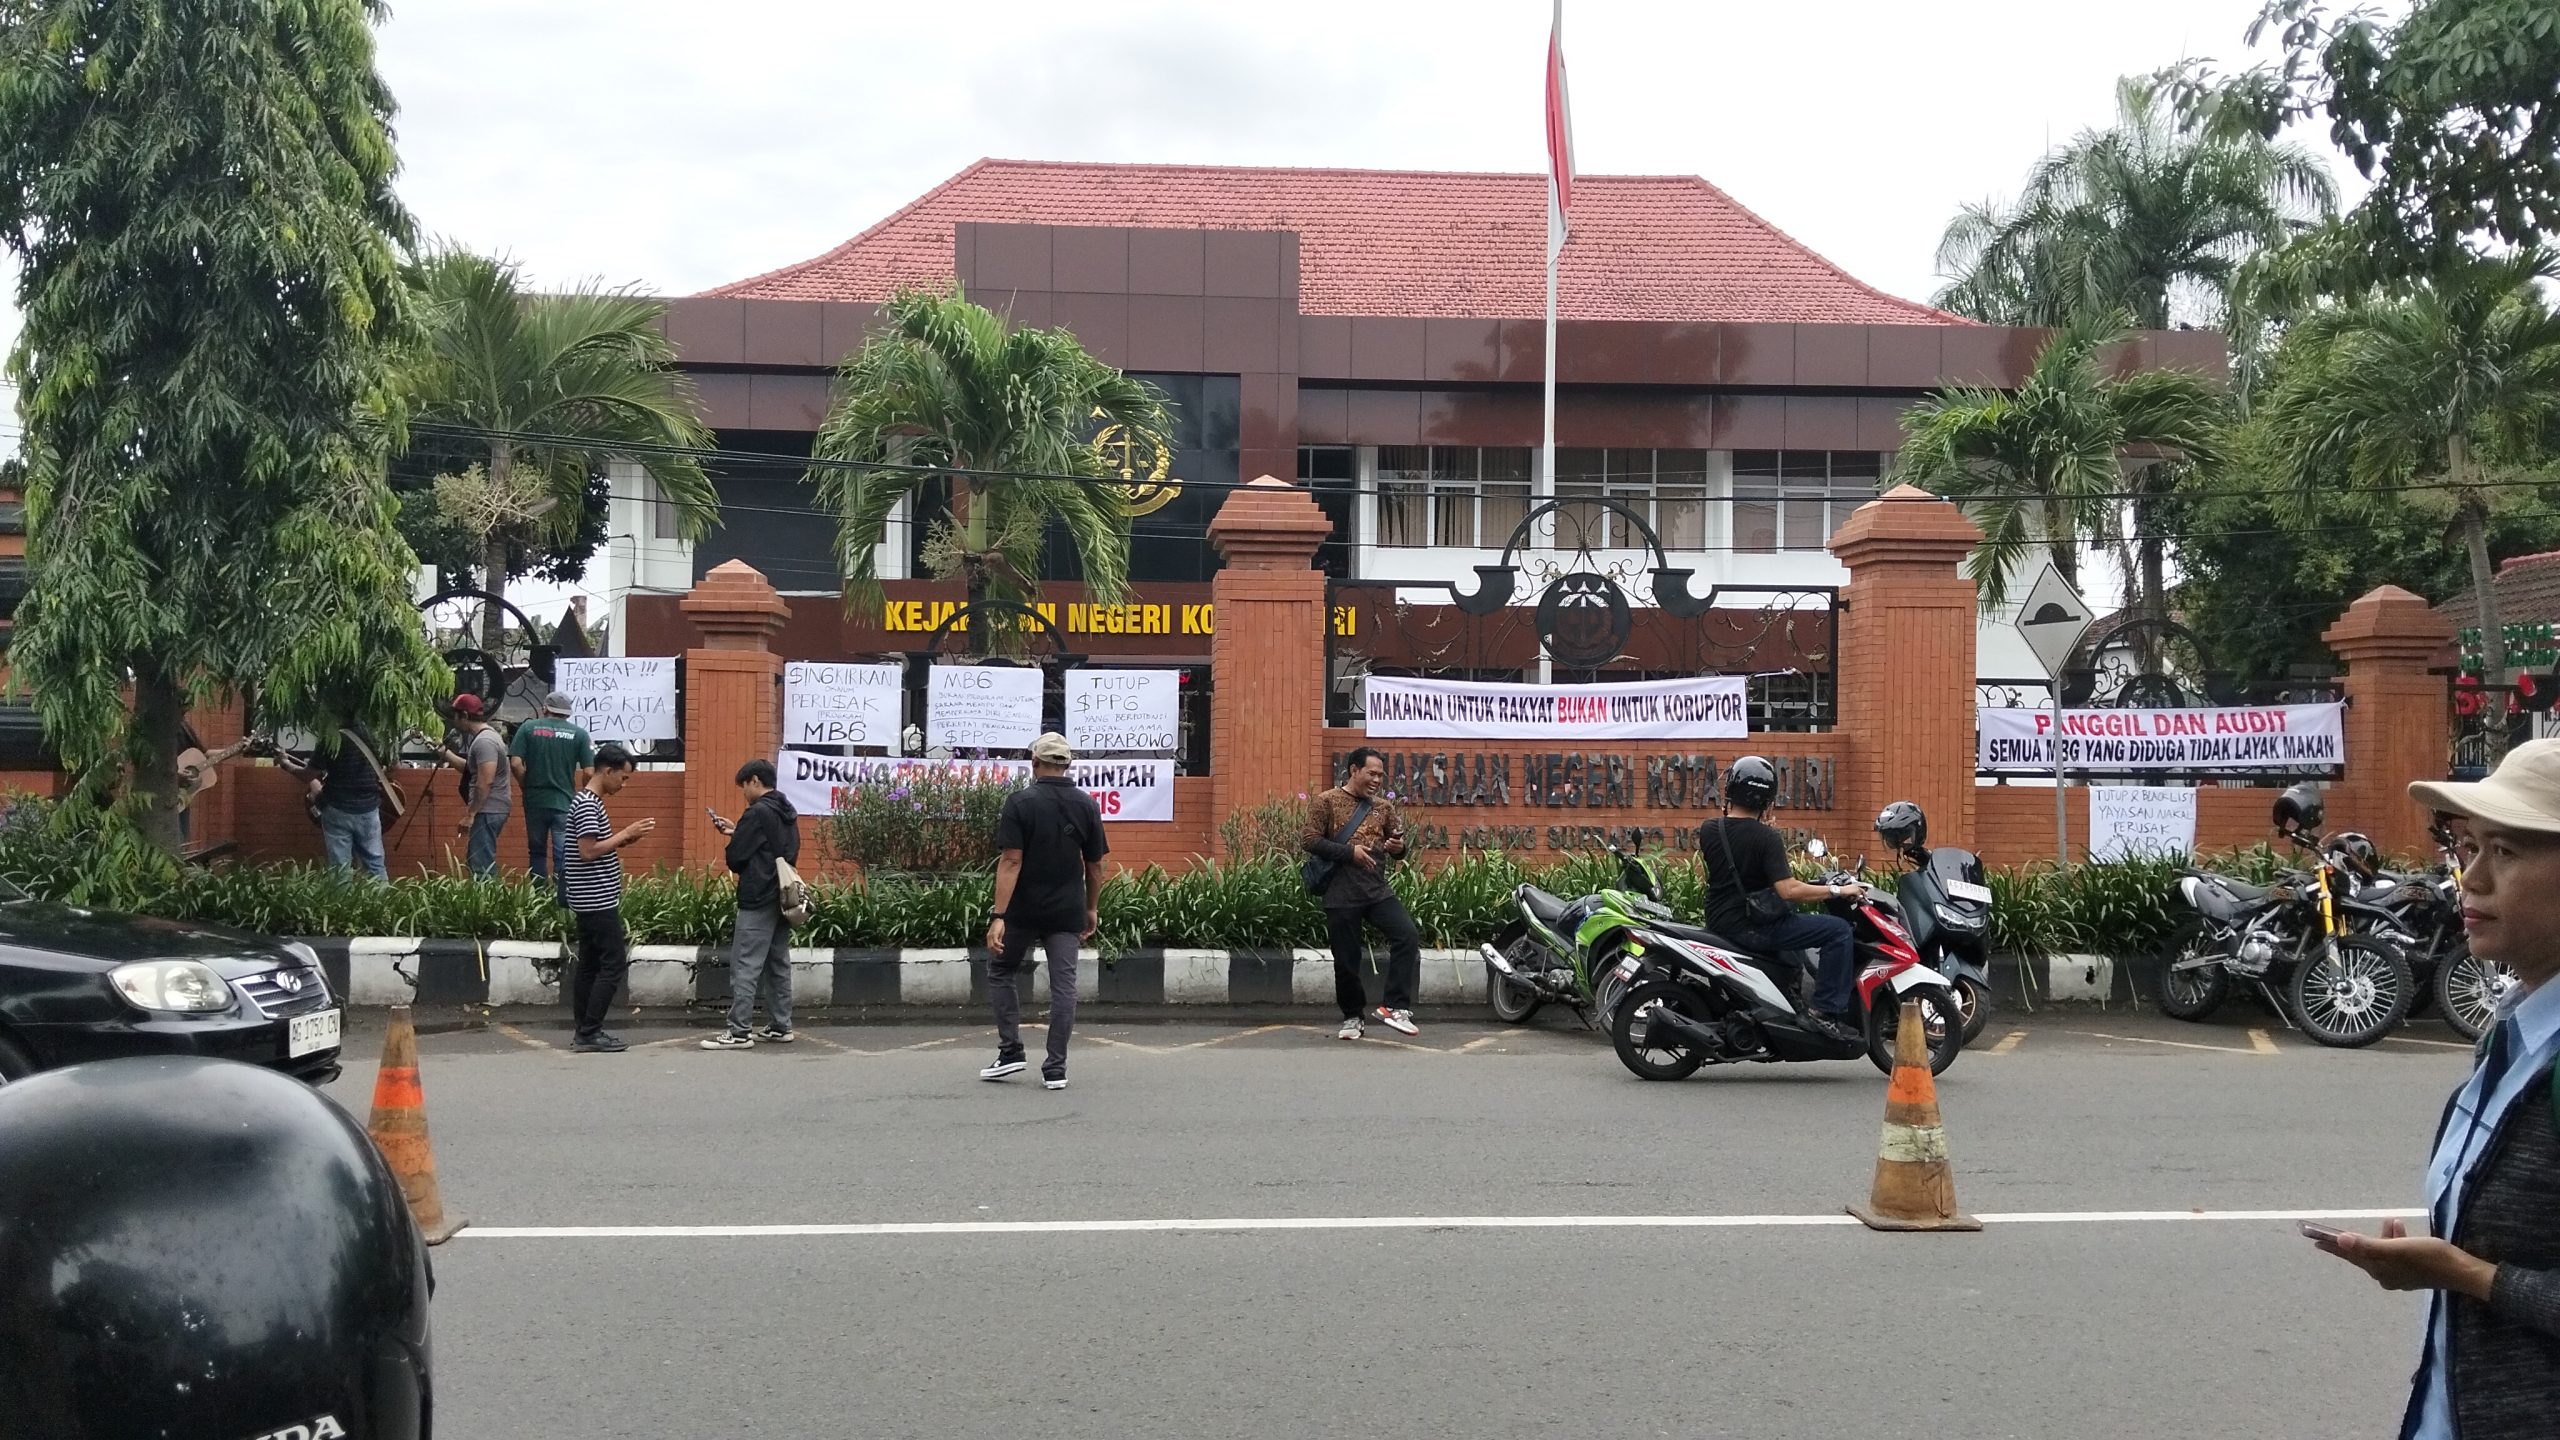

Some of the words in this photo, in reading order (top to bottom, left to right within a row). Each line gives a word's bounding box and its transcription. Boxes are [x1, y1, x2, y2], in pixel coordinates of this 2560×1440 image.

[1068, 603, 1171, 634] NEGERI
[1091, 677, 1150, 690] TUTUP
[622, 696, 666, 714] KITA
[1370, 692, 1443, 721] MAKANAN
[1447, 694, 1495, 723] UNTUK
[1499, 696, 1554, 723] RAKYAT
[1557, 696, 1607, 723] BUKAN
[1611, 695, 1660, 723] UNTUK
[1663, 693, 1742, 722] KORUPTOR
[2153, 713, 2207, 736] DAN
[2215, 710, 2286, 734] AUDIT
[1094, 733, 1173, 748] PRABOWO
[1989, 739, 2041, 762] SEMUA
[2085, 739, 2125, 762] YANG
[2129, 738, 2185, 762] DIDUGA
[2190, 737, 2231, 761] TIDAK
[2235, 736, 2279, 760] LAYAK
[2283, 735, 2334, 759] MAKAN
[797, 757, 890, 783] DUKUNG
[1523, 753, 1634, 807] NEGERI
[1647, 754, 1722, 808] KOTA
[2096, 790, 2129, 801] TUTUP
[2099, 805, 2154, 820] YAYASAN
